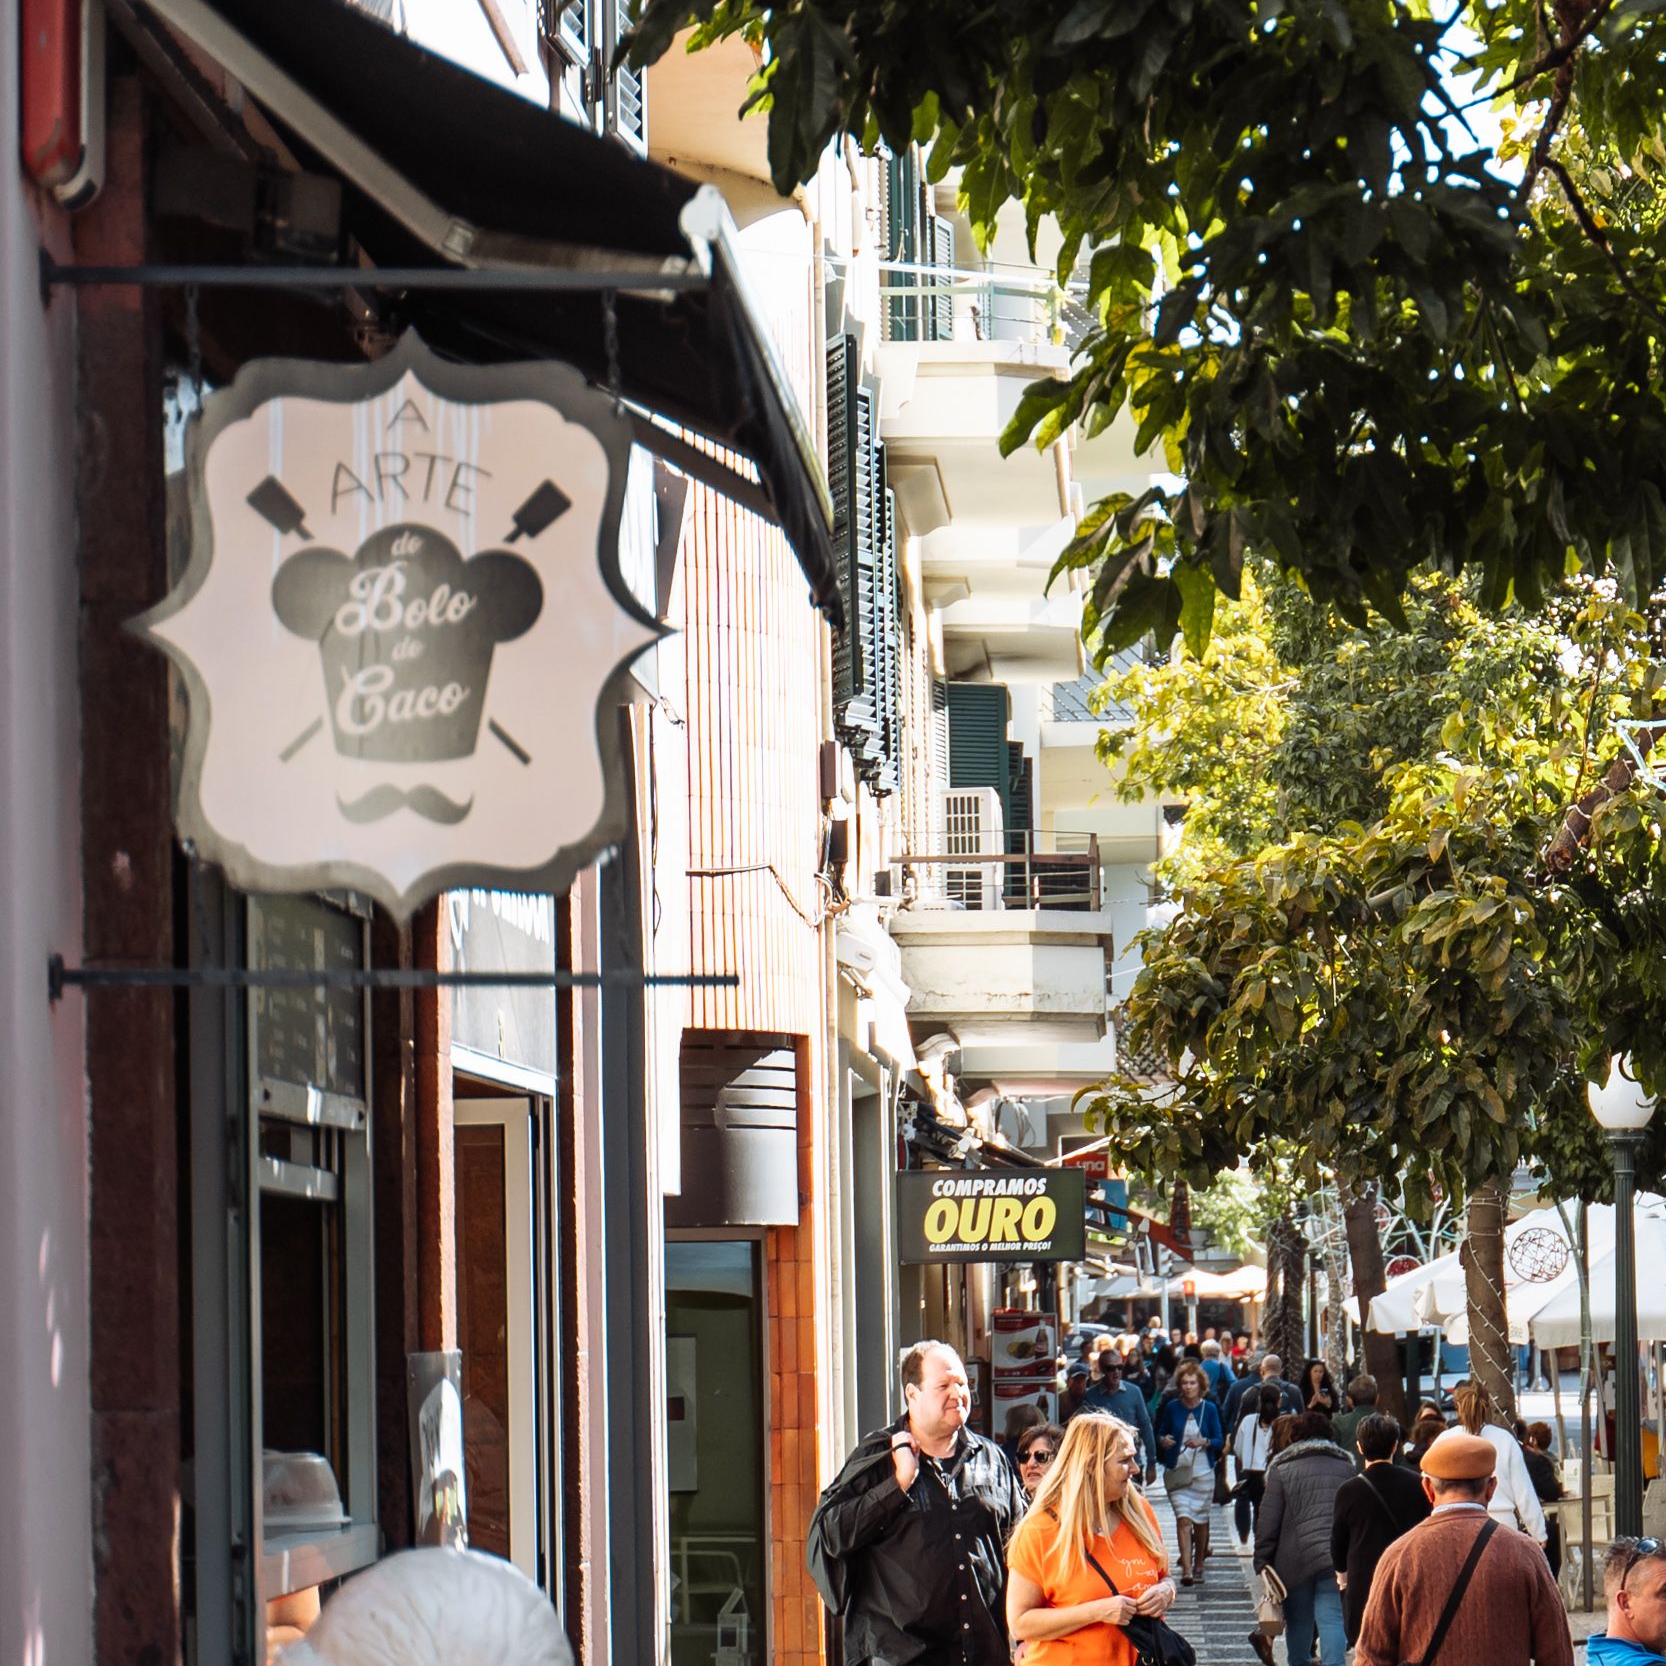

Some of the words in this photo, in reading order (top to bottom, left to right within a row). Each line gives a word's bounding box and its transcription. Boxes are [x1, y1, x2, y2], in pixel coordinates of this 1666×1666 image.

[387, 399, 429, 432] A
[332, 451, 492, 516] ARTE
[335, 561, 477, 634] Bolo
[336, 664, 471, 734] Caco
[932, 1178, 1047, 1197] COMPRAMOS
[924, 1196, 1057, 1244] OURO
[929, 1242, 980, 1252] GARANTIMOS
[981, 1243, 989, 1251] O
[989, 1242, 1022, 1251] MELHOR
[1023, 1241, 1052, 1252] PREÇO!
